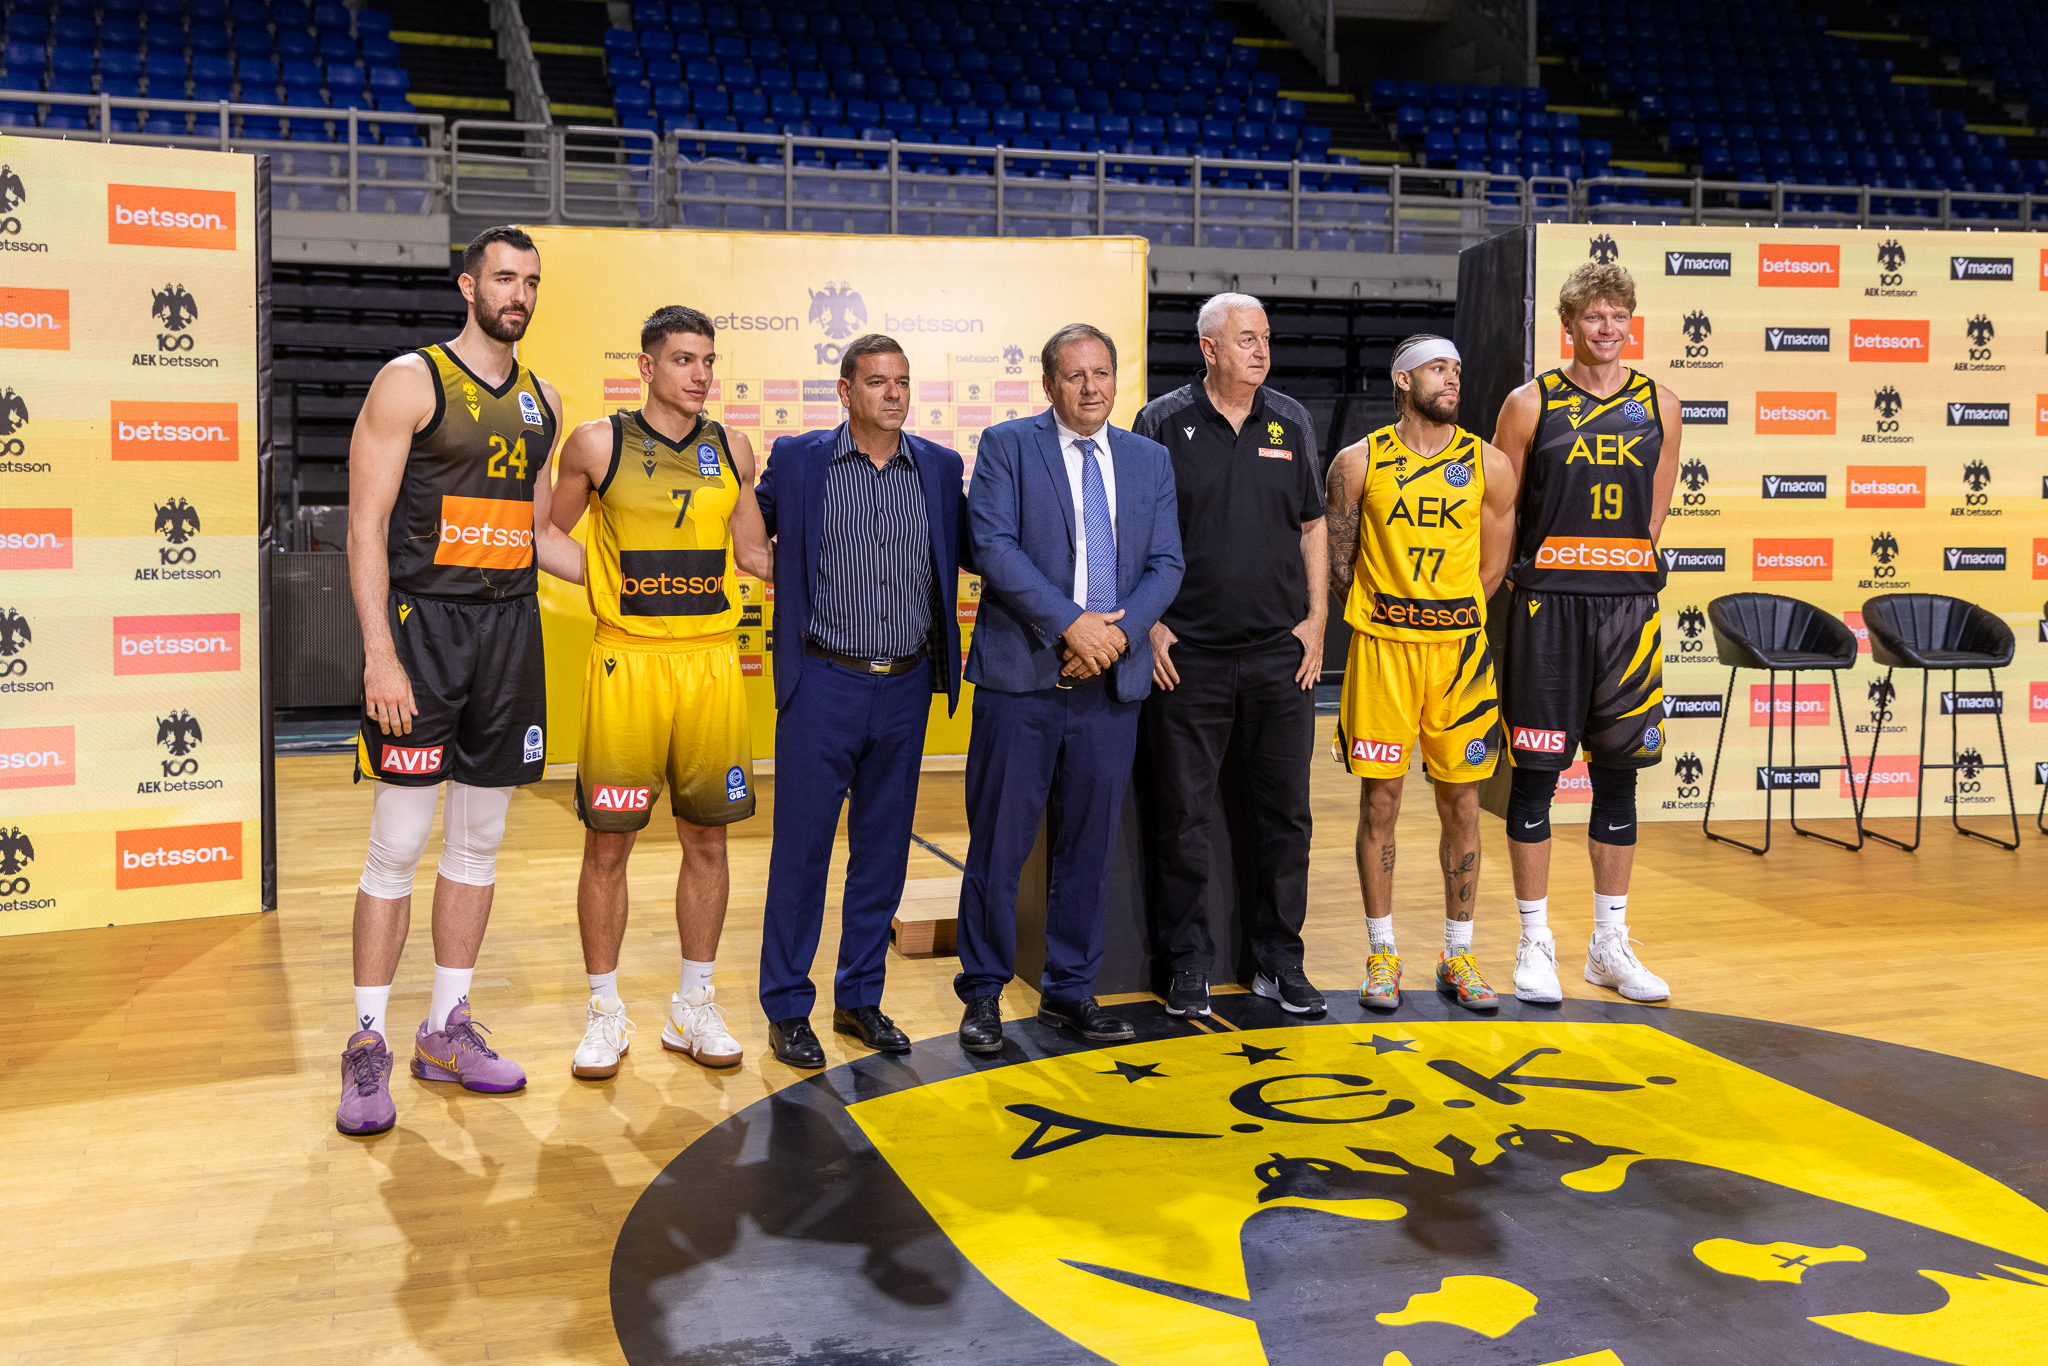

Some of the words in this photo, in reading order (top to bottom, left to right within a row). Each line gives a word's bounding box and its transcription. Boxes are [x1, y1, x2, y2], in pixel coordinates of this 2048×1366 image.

[1683, 257, 1729, 270] macron
[1968, 264, 2011, 274] macron
[1880, 274, 1902, 286] 100
[1865, 288, 1879, 296] AEK
[1881, 289, 1917, 297] betsson
[706, 312, 799, 331] etsson
[884, 313, 984, 333] betsson
[157, 333, 194, 352] 100
[1783, 334, 1828, 346] macron
[1686, 346, 1708, 357] 100
[1969, 349, 1991, 361] 100
[132, 353, 156, 367] AEK
[159, 354, 218, 368] betsson
[955, 354, 999, 364] betsson
[1670, 360, 1685, 368] AEK
[1686, 360, 1723, 368] betsson
[1005, 366, 1022, 375] 100
[1954, 363, 1968, 371] AEK
[1970, 363, 2005, 371] betsson
[604, 386, 641, 394] betsson
[764, 386, 799, 395] betsson
[804, 386, 837, 395] macron
[724, 411, 760, 420] betsson
[803, 411, 839, 420] betsson
[1682, 407, 1726, 418] macron
[1964, 408, 2008, 420] macron
[524, 414, 541, 424] GBL
[1877, 420, 1899, 432] 100
[1861, 435, 1876, 443] AEK
[1877, 435, 1913, 443] betsson
[1259, 448, 1292, 460] betsson
[1565, 434, 1644, 467] AEK
[487, 435, 529, 480] 24
[701, 467, 720, 475] GBL
[1780, 482, 1825, 492] macron
[1590, 482, 1623, 520] 19
[1683, 493, 1705, 506] 100
[1966, 494, 1987, 506] 100
[672, 489, 692, 529] 7
[1386, 495, 1467, 529] AEK
[1684, 508, 1720, 516] betsson
[1950, 508, 1965, 516] AEK
[1966, 508, 2002, 516] betsson
[440, 518, 533, 548] betsso
[159, 547, 196, 565] 100
[1678, 555, 1723, 566] macron
[1961, 553, 2004, 565] macron
[1408, 547, 1446, 583] 77
[135, 568, 159, 581] AEK
[162, 568, 221, 580] betsson
[1873, 566, 1896, 578] 100
[1858, 580, 1872, 588] AEK
[1874, 580, 1910, 588] betsson
[742, 612, 761, 620] cron
[1372, 602, 1481, 626] betsson
[1680, 640, 1703, 652] 100
[1664, 655, 1680, 663] AEK
[741, 662, 762, 670] sson
[1675, 701, 1720, 712] macron
[1855, 725, 1869, 733] AEK
[1513, 730, 1565, 751] AVIS
[525, 750, 542, 761] GBL
[1351, 741, 1401, 762] AVIS
[383, 748, 442, 771] AVIS
[161, 758, 198, 777] 100
[137, 781, 161, 793] AEK
[164, 778, 222, 792] betsson
[1559, 775, 1593, 789] bets
[1959, 781, 1981, 793] 100
[594, 787, 648, 809] AVIS
[729, 790, 747, 801] GBL
[1677, 786, 1700, 798] 100
[1662, 801, 1676, 809] AEK
[1944, 796, 1957, 804] AE
